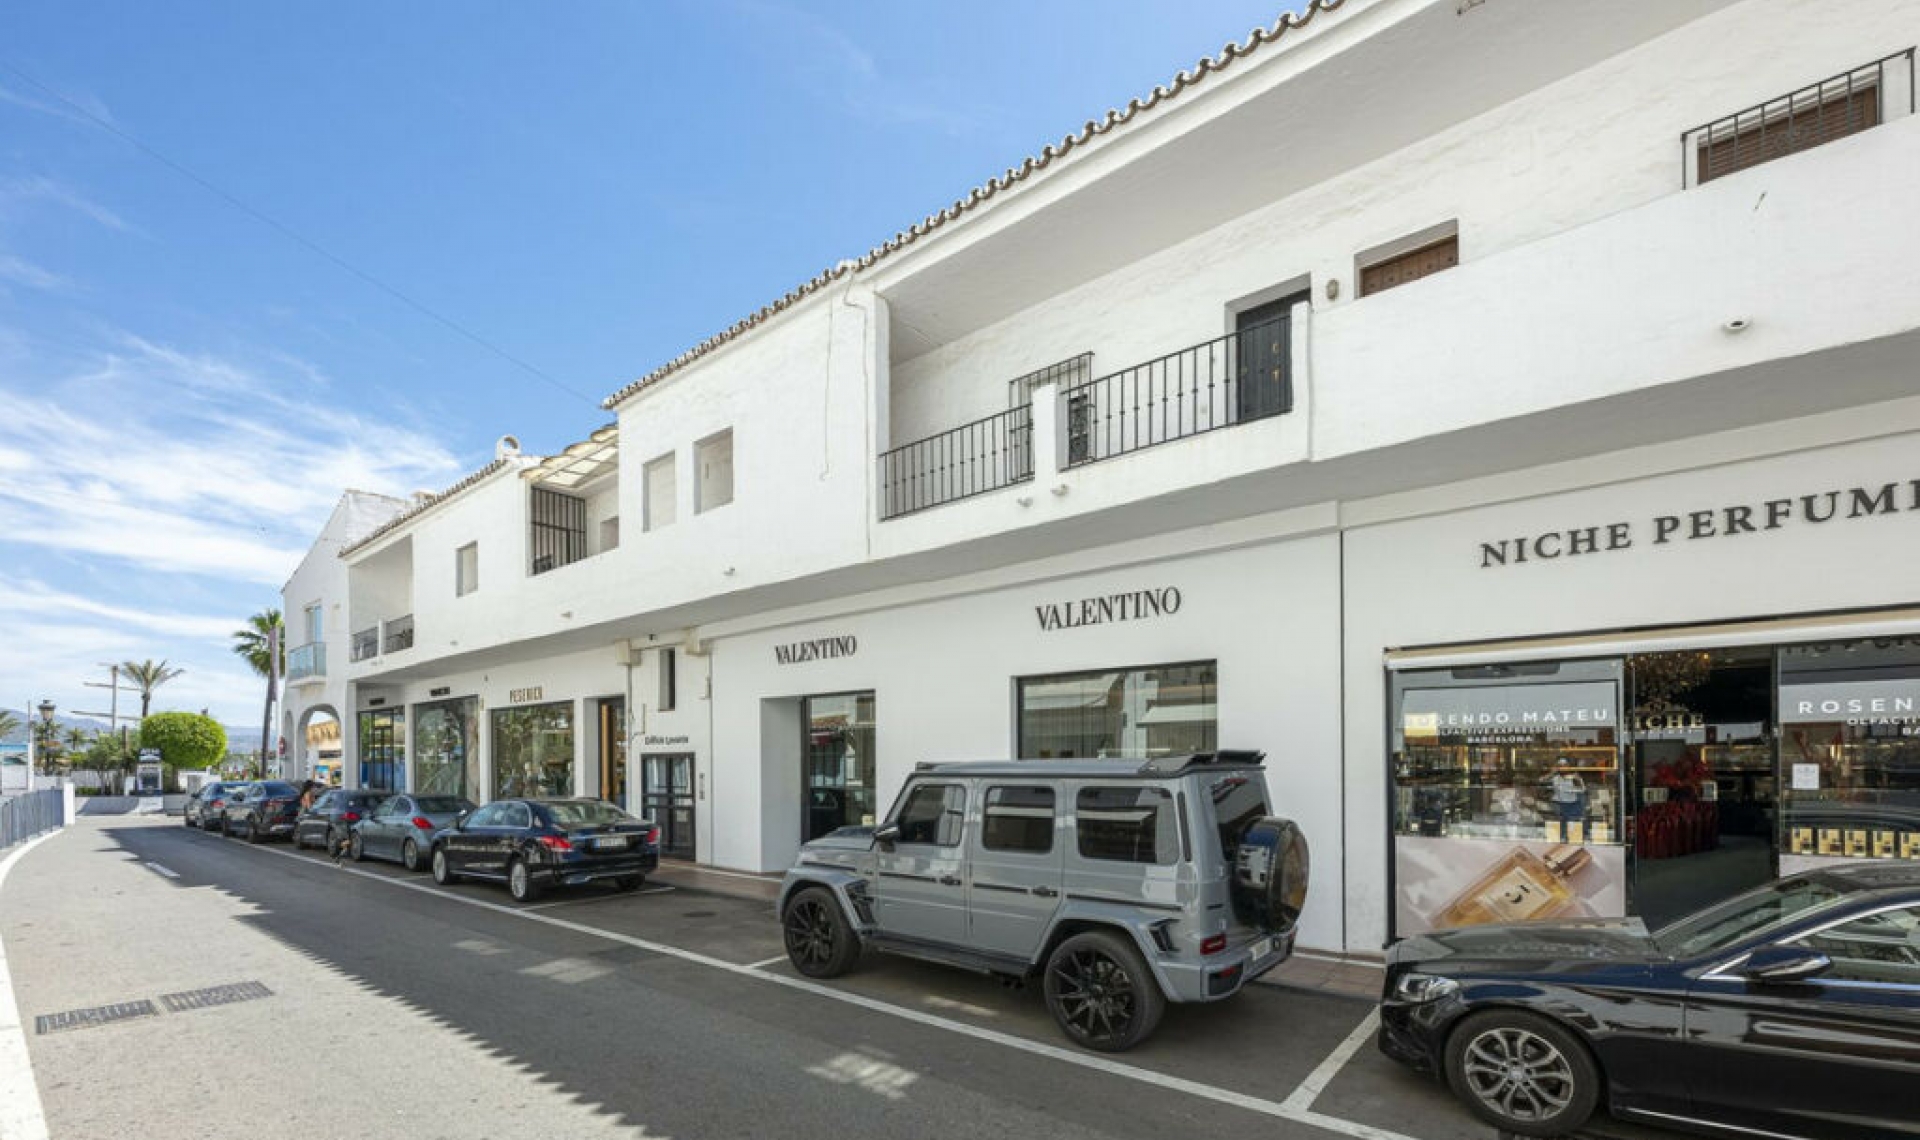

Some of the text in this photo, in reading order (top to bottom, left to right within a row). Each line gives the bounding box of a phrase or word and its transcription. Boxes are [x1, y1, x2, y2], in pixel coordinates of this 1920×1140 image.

[1480, 522, 1632, 568] NICHE
[1035, 585, 1182, 632] VALENTINO
[776, 634, 858, 665] VALENTINO
[1403, 708, 1609, 727] SENDO MATEU
[1799, 697, 1913, 714] ROSEN
